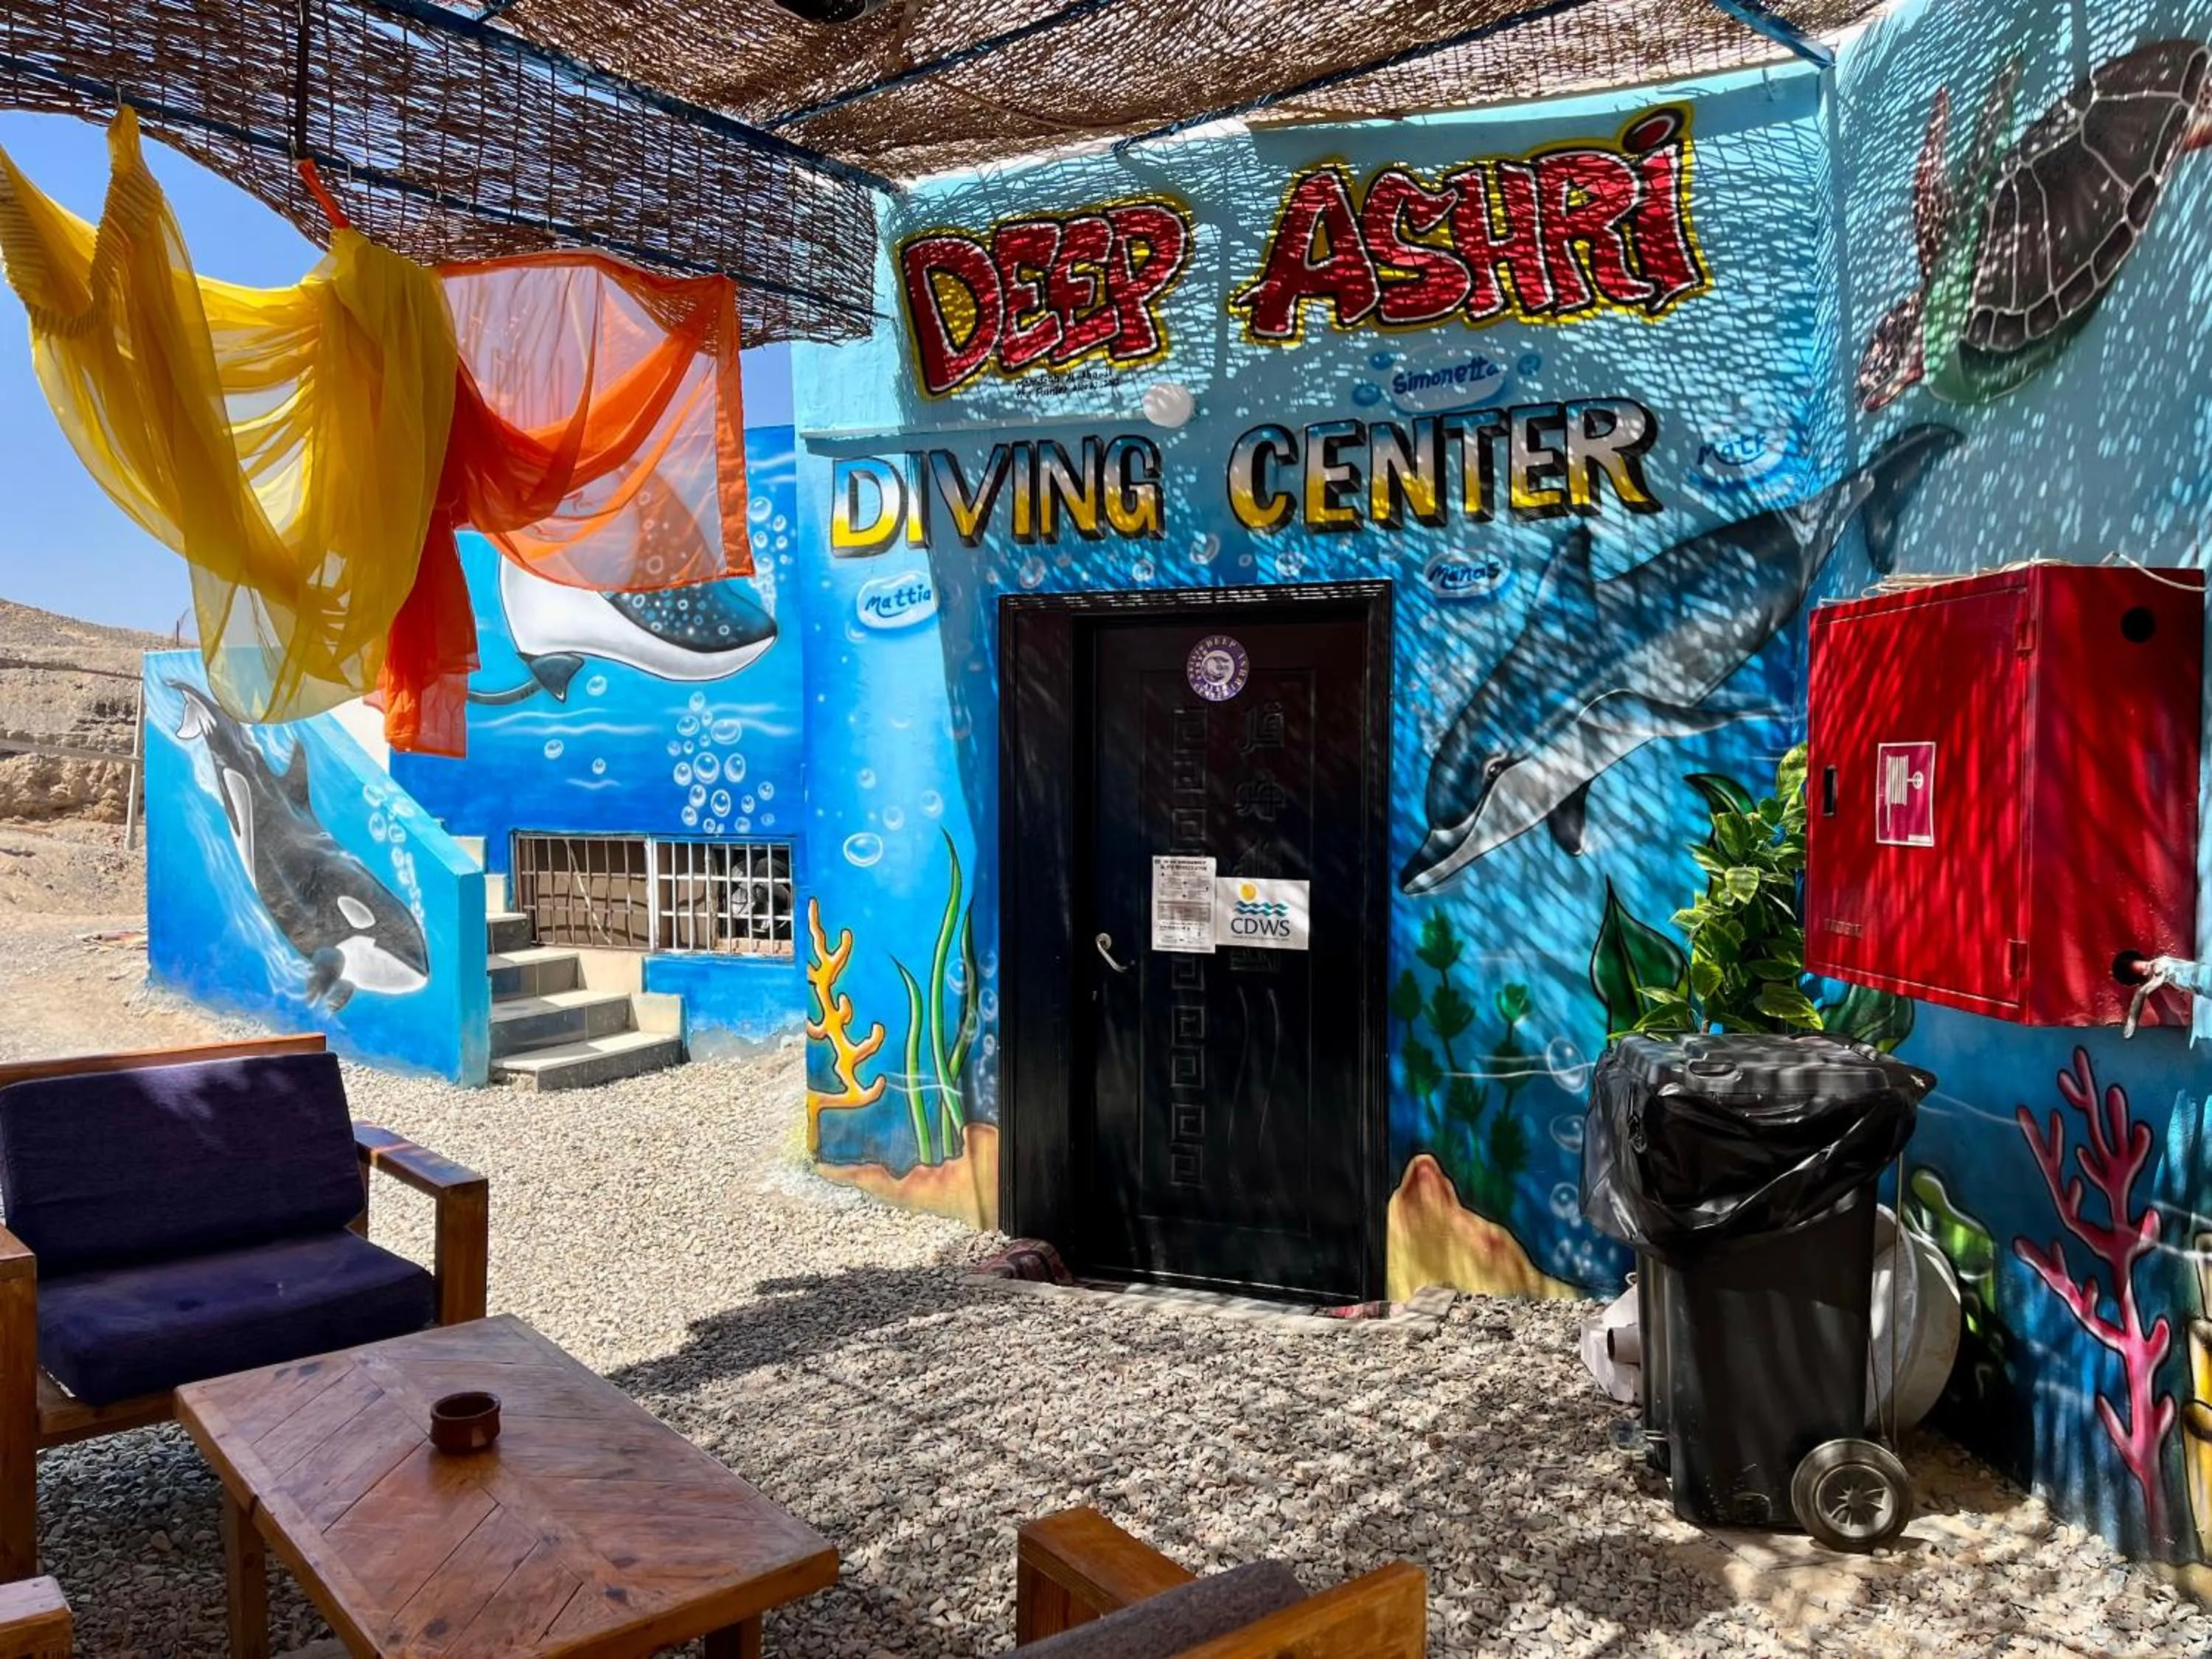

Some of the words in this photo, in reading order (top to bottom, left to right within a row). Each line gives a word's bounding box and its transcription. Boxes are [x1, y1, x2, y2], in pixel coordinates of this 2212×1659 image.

[897, 201, 1193, 397] DEEP
[1392, 355, 1501, 395] Simonetta
[832, 434, 1165, 557] DIVING
[1226, 397, 1664, 535] CENTER
[864, 583, 932, 619] Mattia
[1230, 917, 1291, 937] CDWS
